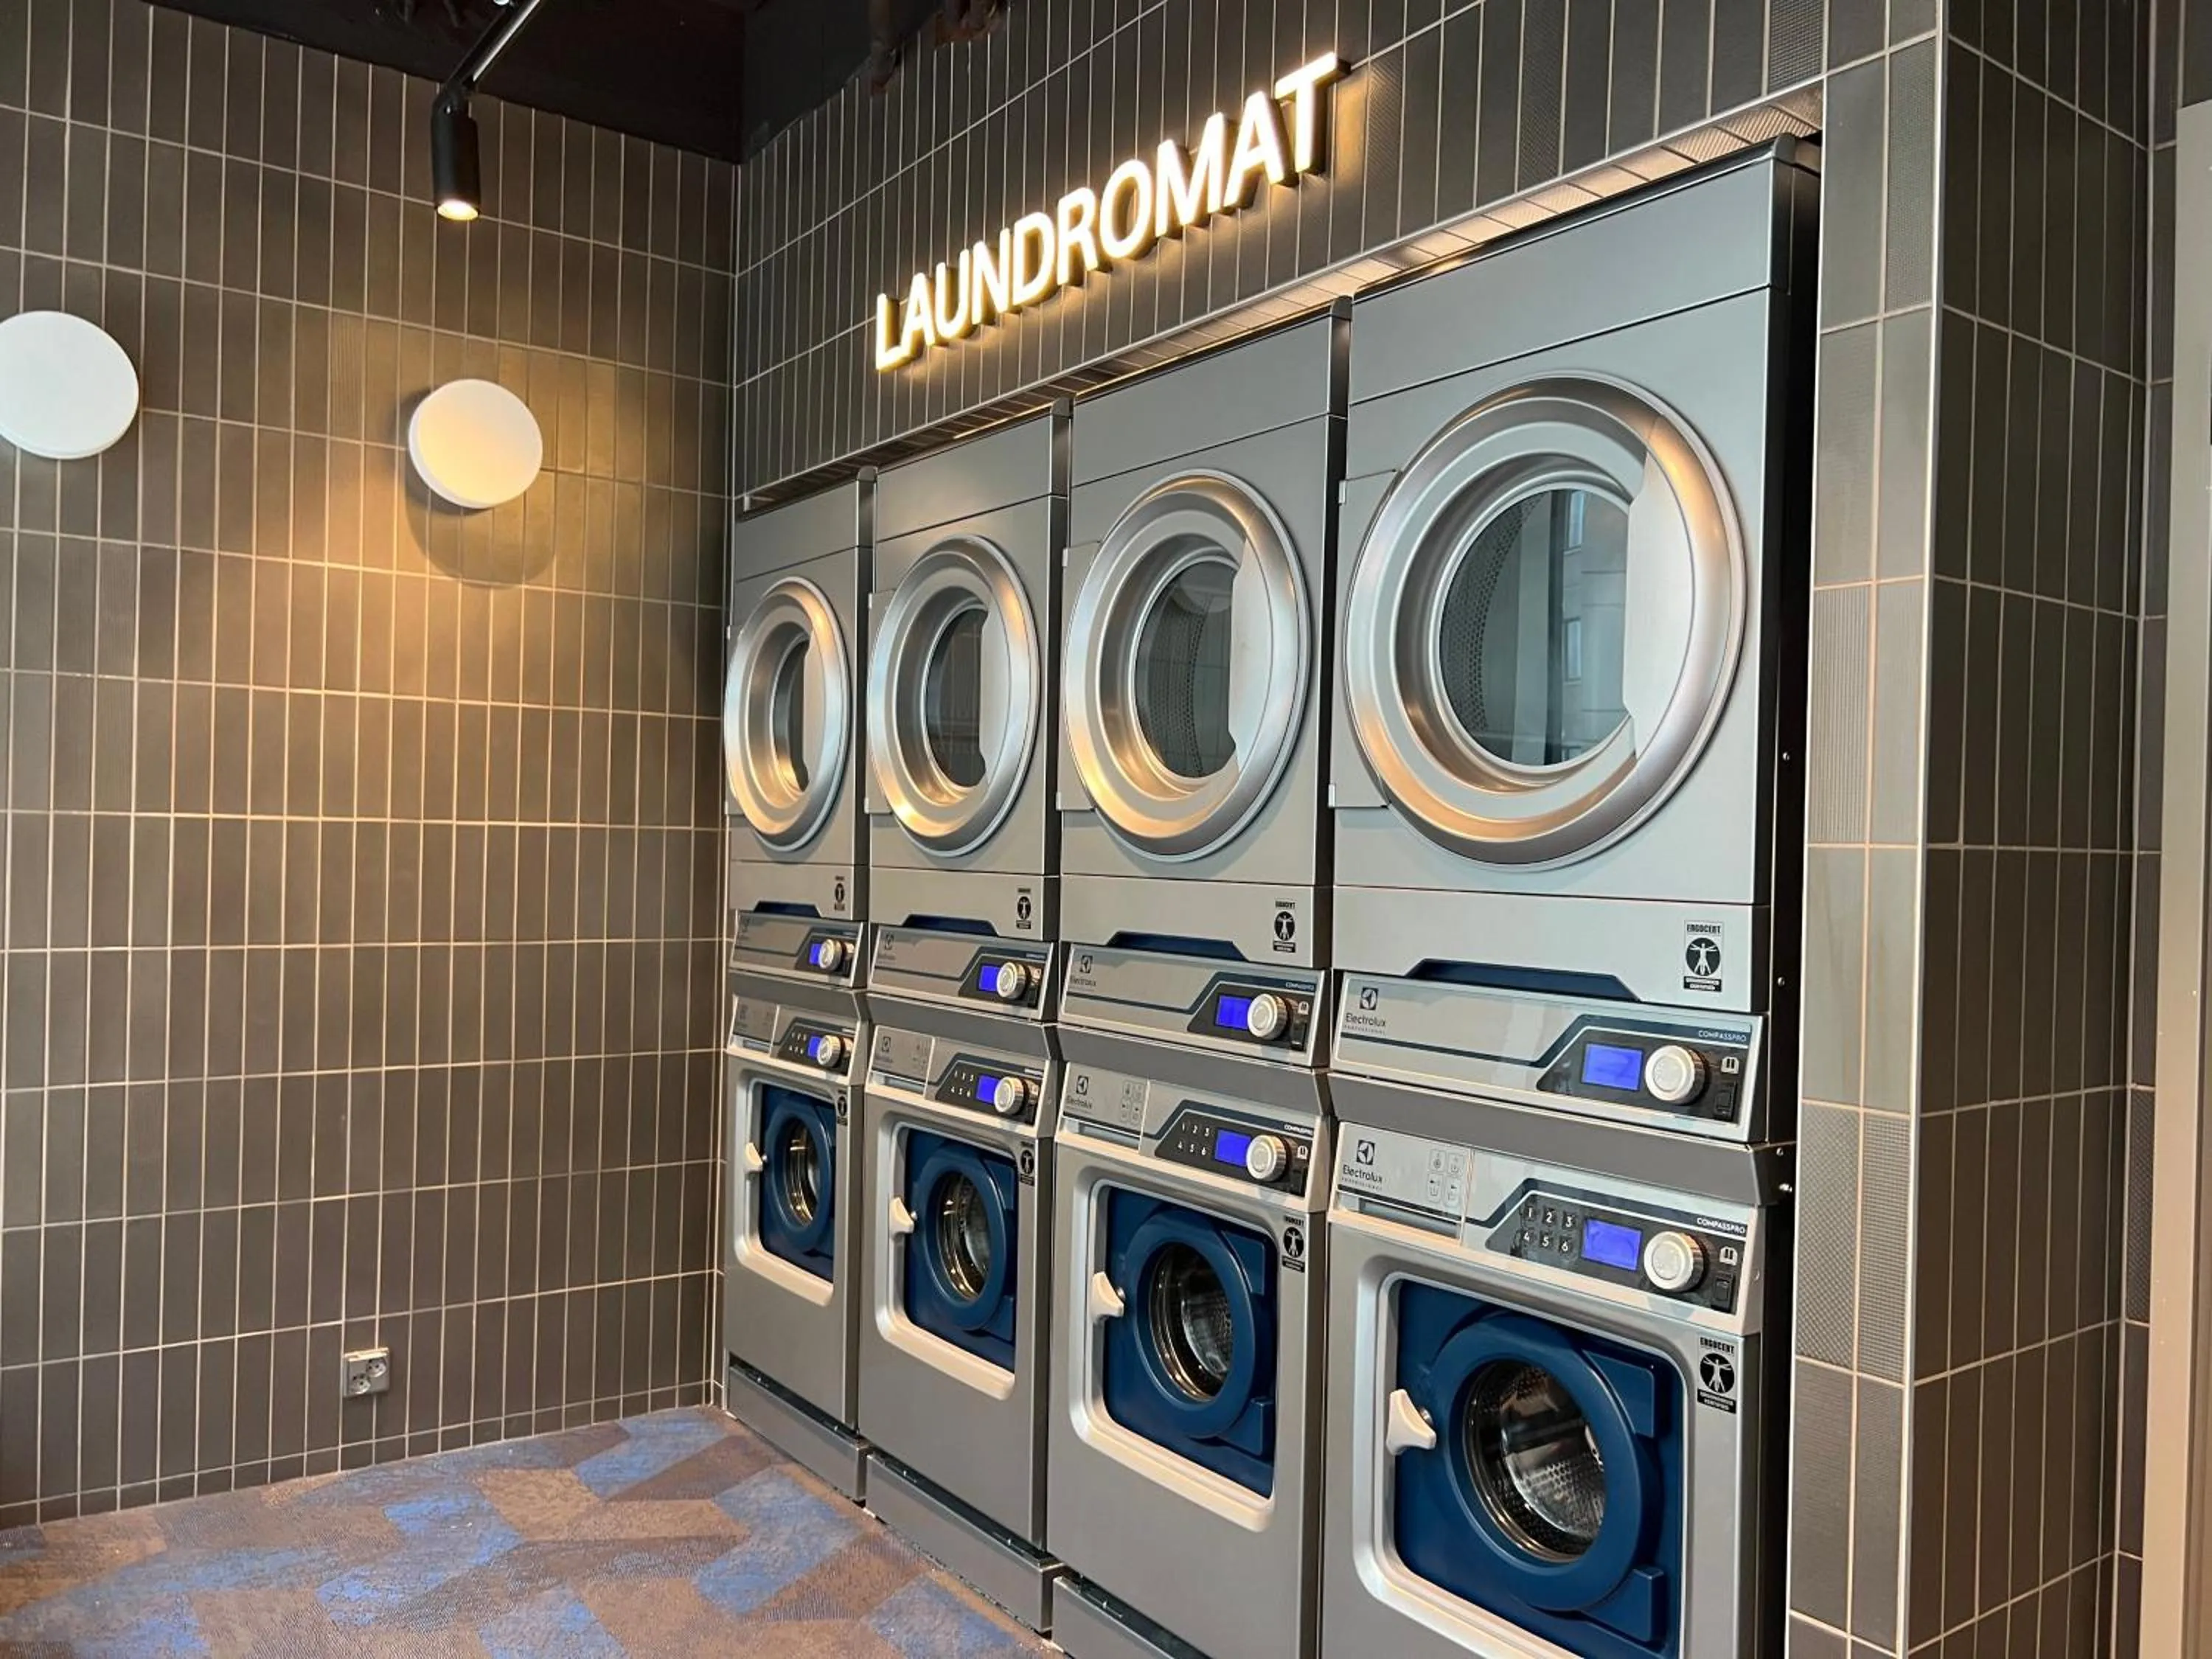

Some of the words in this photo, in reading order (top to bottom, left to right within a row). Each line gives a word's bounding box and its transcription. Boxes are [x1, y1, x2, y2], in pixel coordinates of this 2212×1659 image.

[876, 52, 1338, 371] LAUNDROMAT
[1346, 1012, 1386, 1027] Electrolux
[1698, 1030, 1747, 1042] COMPASSPRO
[1343, 1164, 1382, 1183] Electrolux
[1546, 1211, 1553, 1223] 2
[1565, 1216, 1572, 1228] 3
[1697, 1217, 1745, 1234] COMPASSPRO
[1523, 1231, 1530, 1242] 4
[1542, 1236, 1549, 1247] 5
[1561, 1241, 1568, 1252] 6
